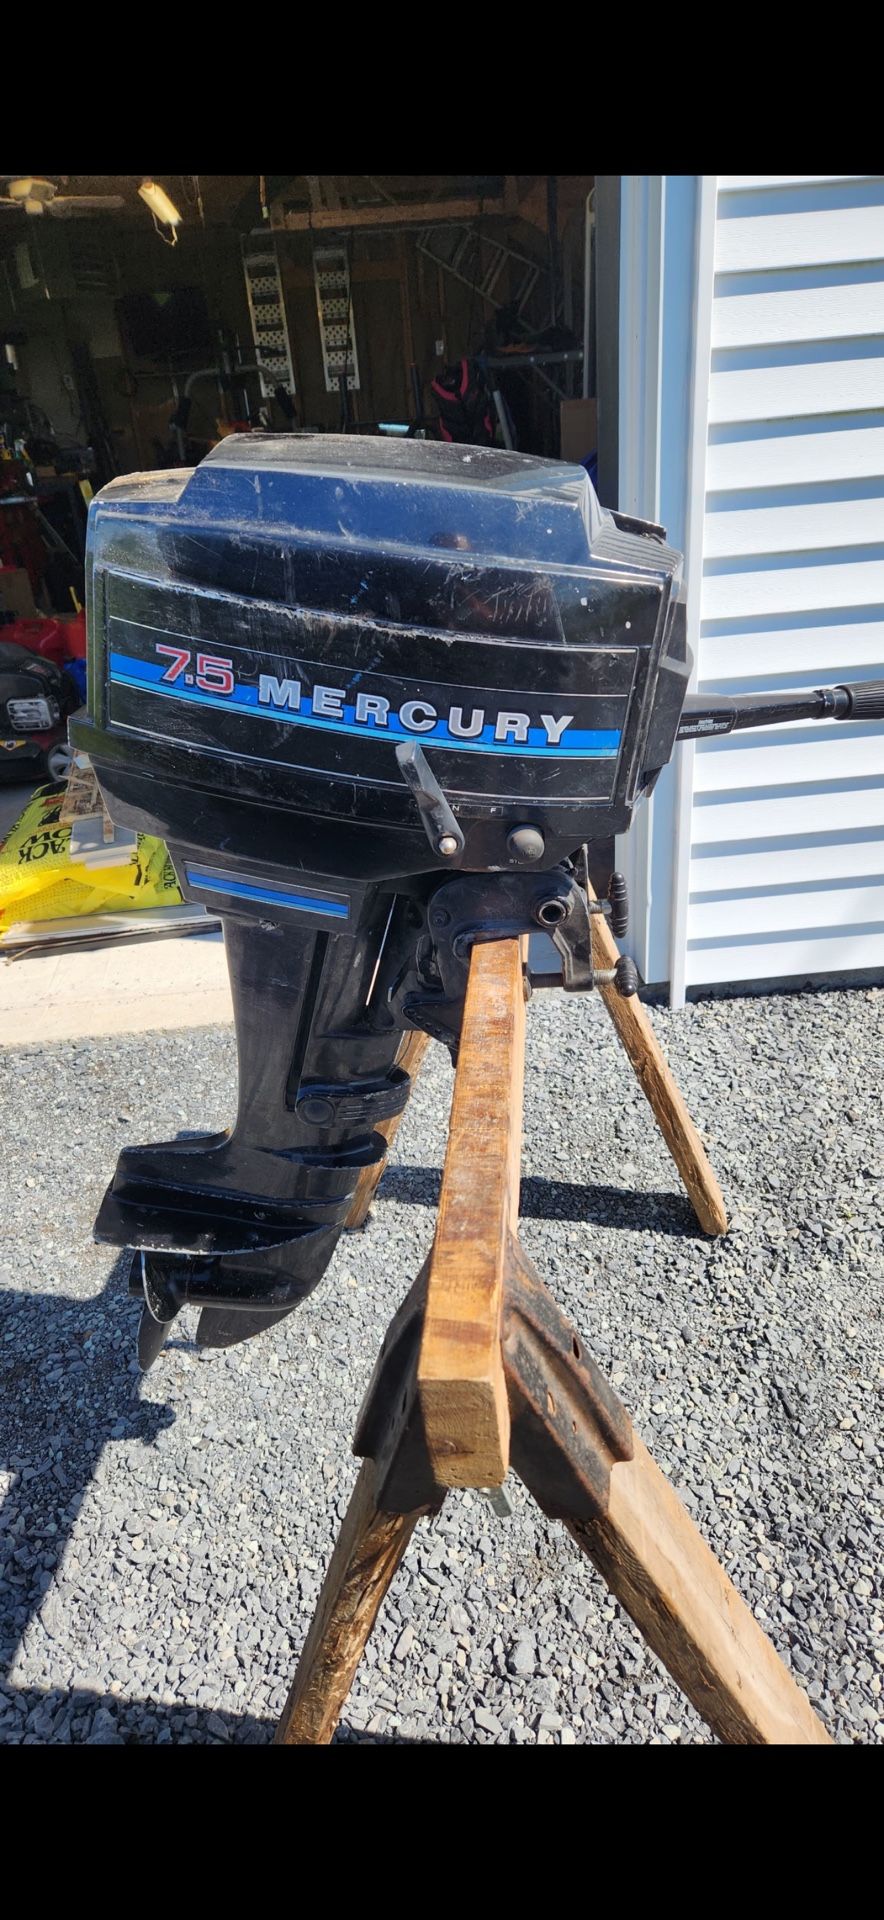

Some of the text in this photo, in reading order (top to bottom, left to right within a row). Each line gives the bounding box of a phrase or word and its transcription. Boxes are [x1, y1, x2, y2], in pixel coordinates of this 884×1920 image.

[155, 643, 574, 745] 7.5 MERCURY
[20, 827, 73, 848] OW
[18, 838, 72, 865] ACK
